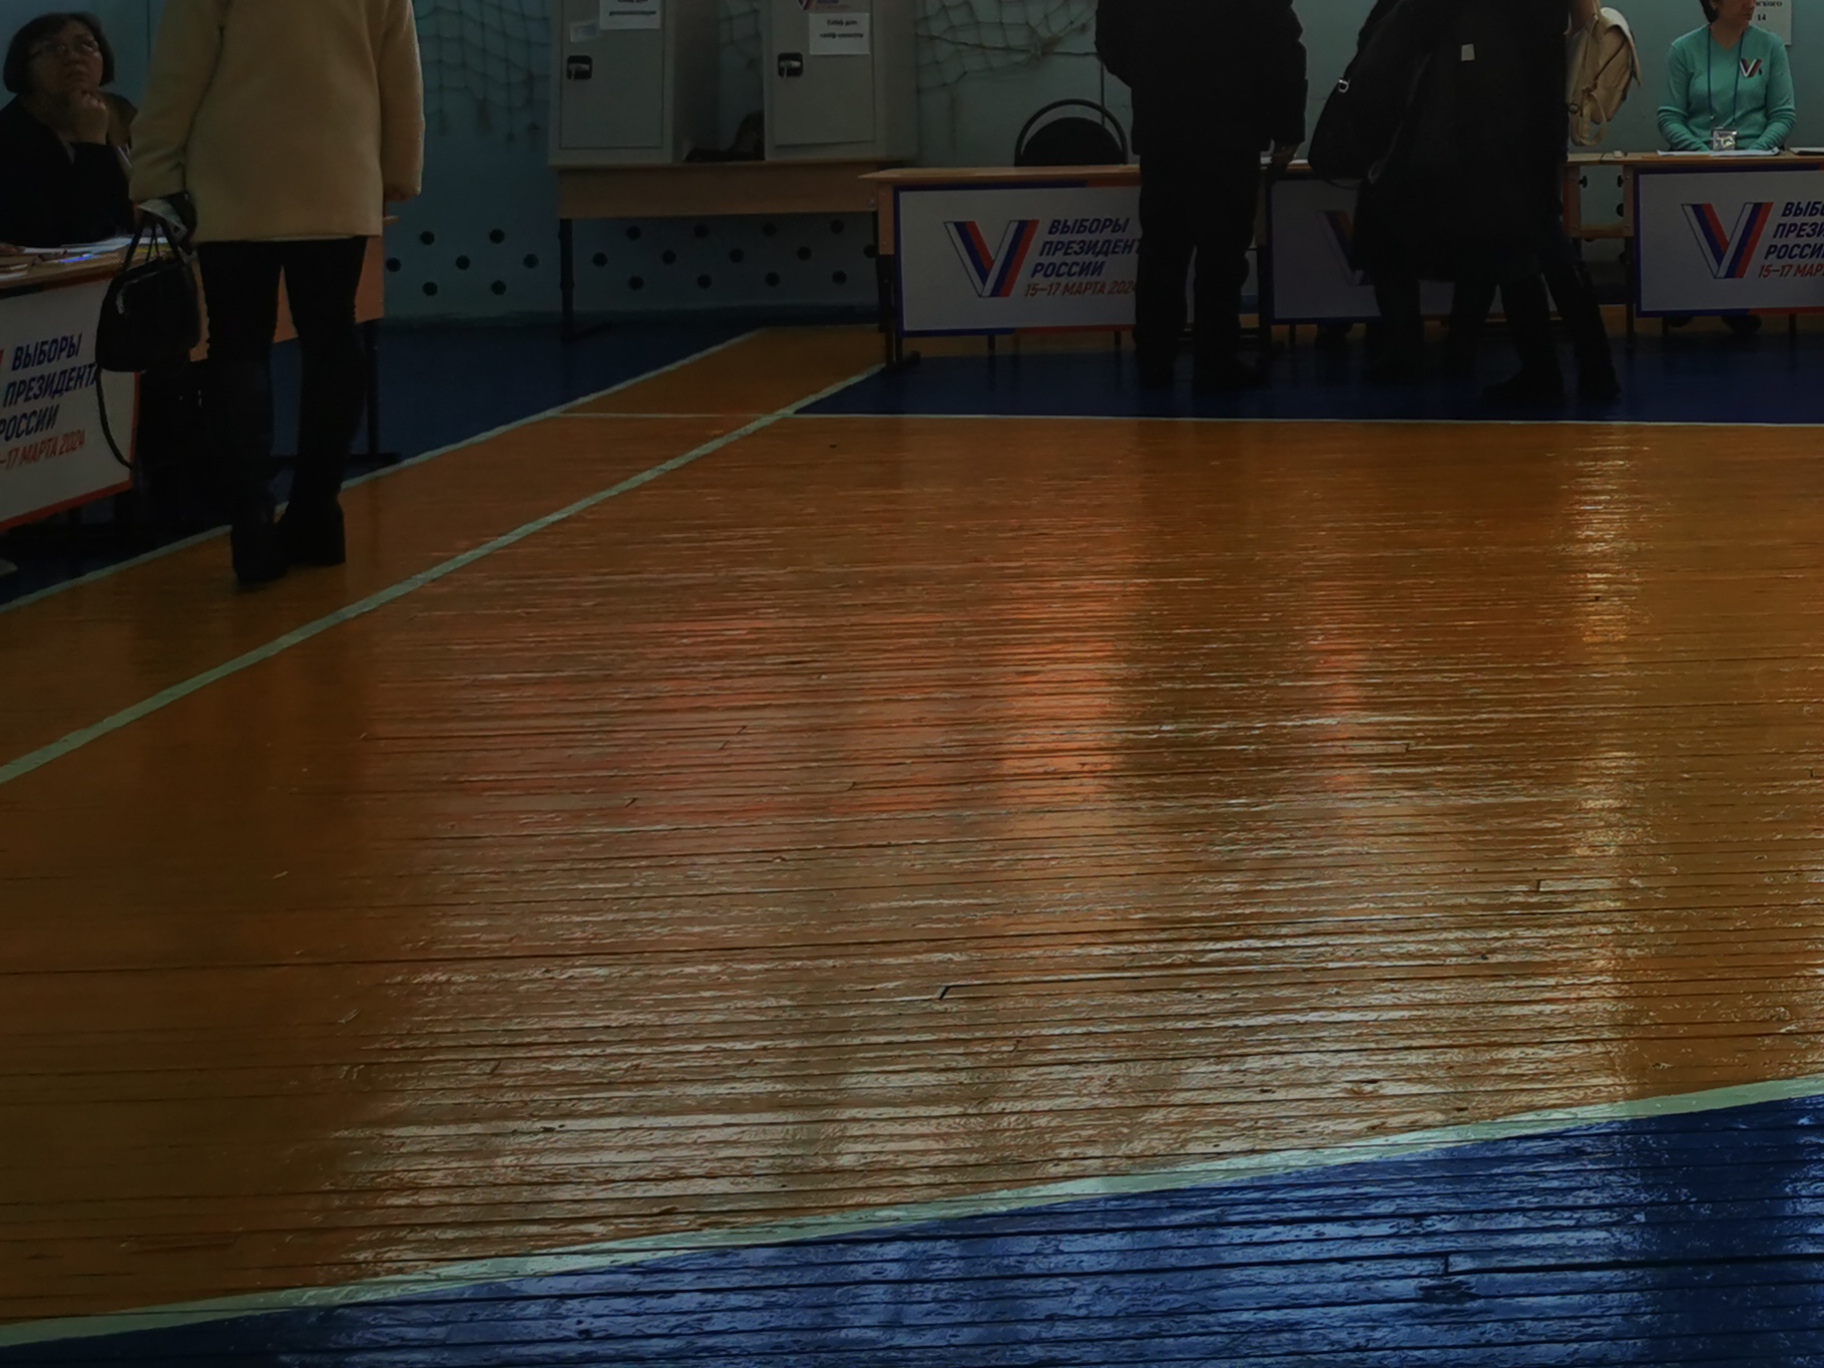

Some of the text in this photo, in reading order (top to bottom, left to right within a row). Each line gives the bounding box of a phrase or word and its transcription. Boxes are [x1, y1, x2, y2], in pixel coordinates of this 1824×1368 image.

[1757, 13, 1766, 21] 14
[1048, 218, 1130, 235] ВЫБОРЫ
[1039, 238, 1142, 257] ПРЕЗИДЕНТ
[1031, 261, 1106, 278] РОССИИ
[1062, 282, 1105, 296] МАРТА
[12, 333, 83, 371] ВЫБОРЫ
[19, 436, 58, 466] МАРТА
[59, 429, 85, 455] 2024
